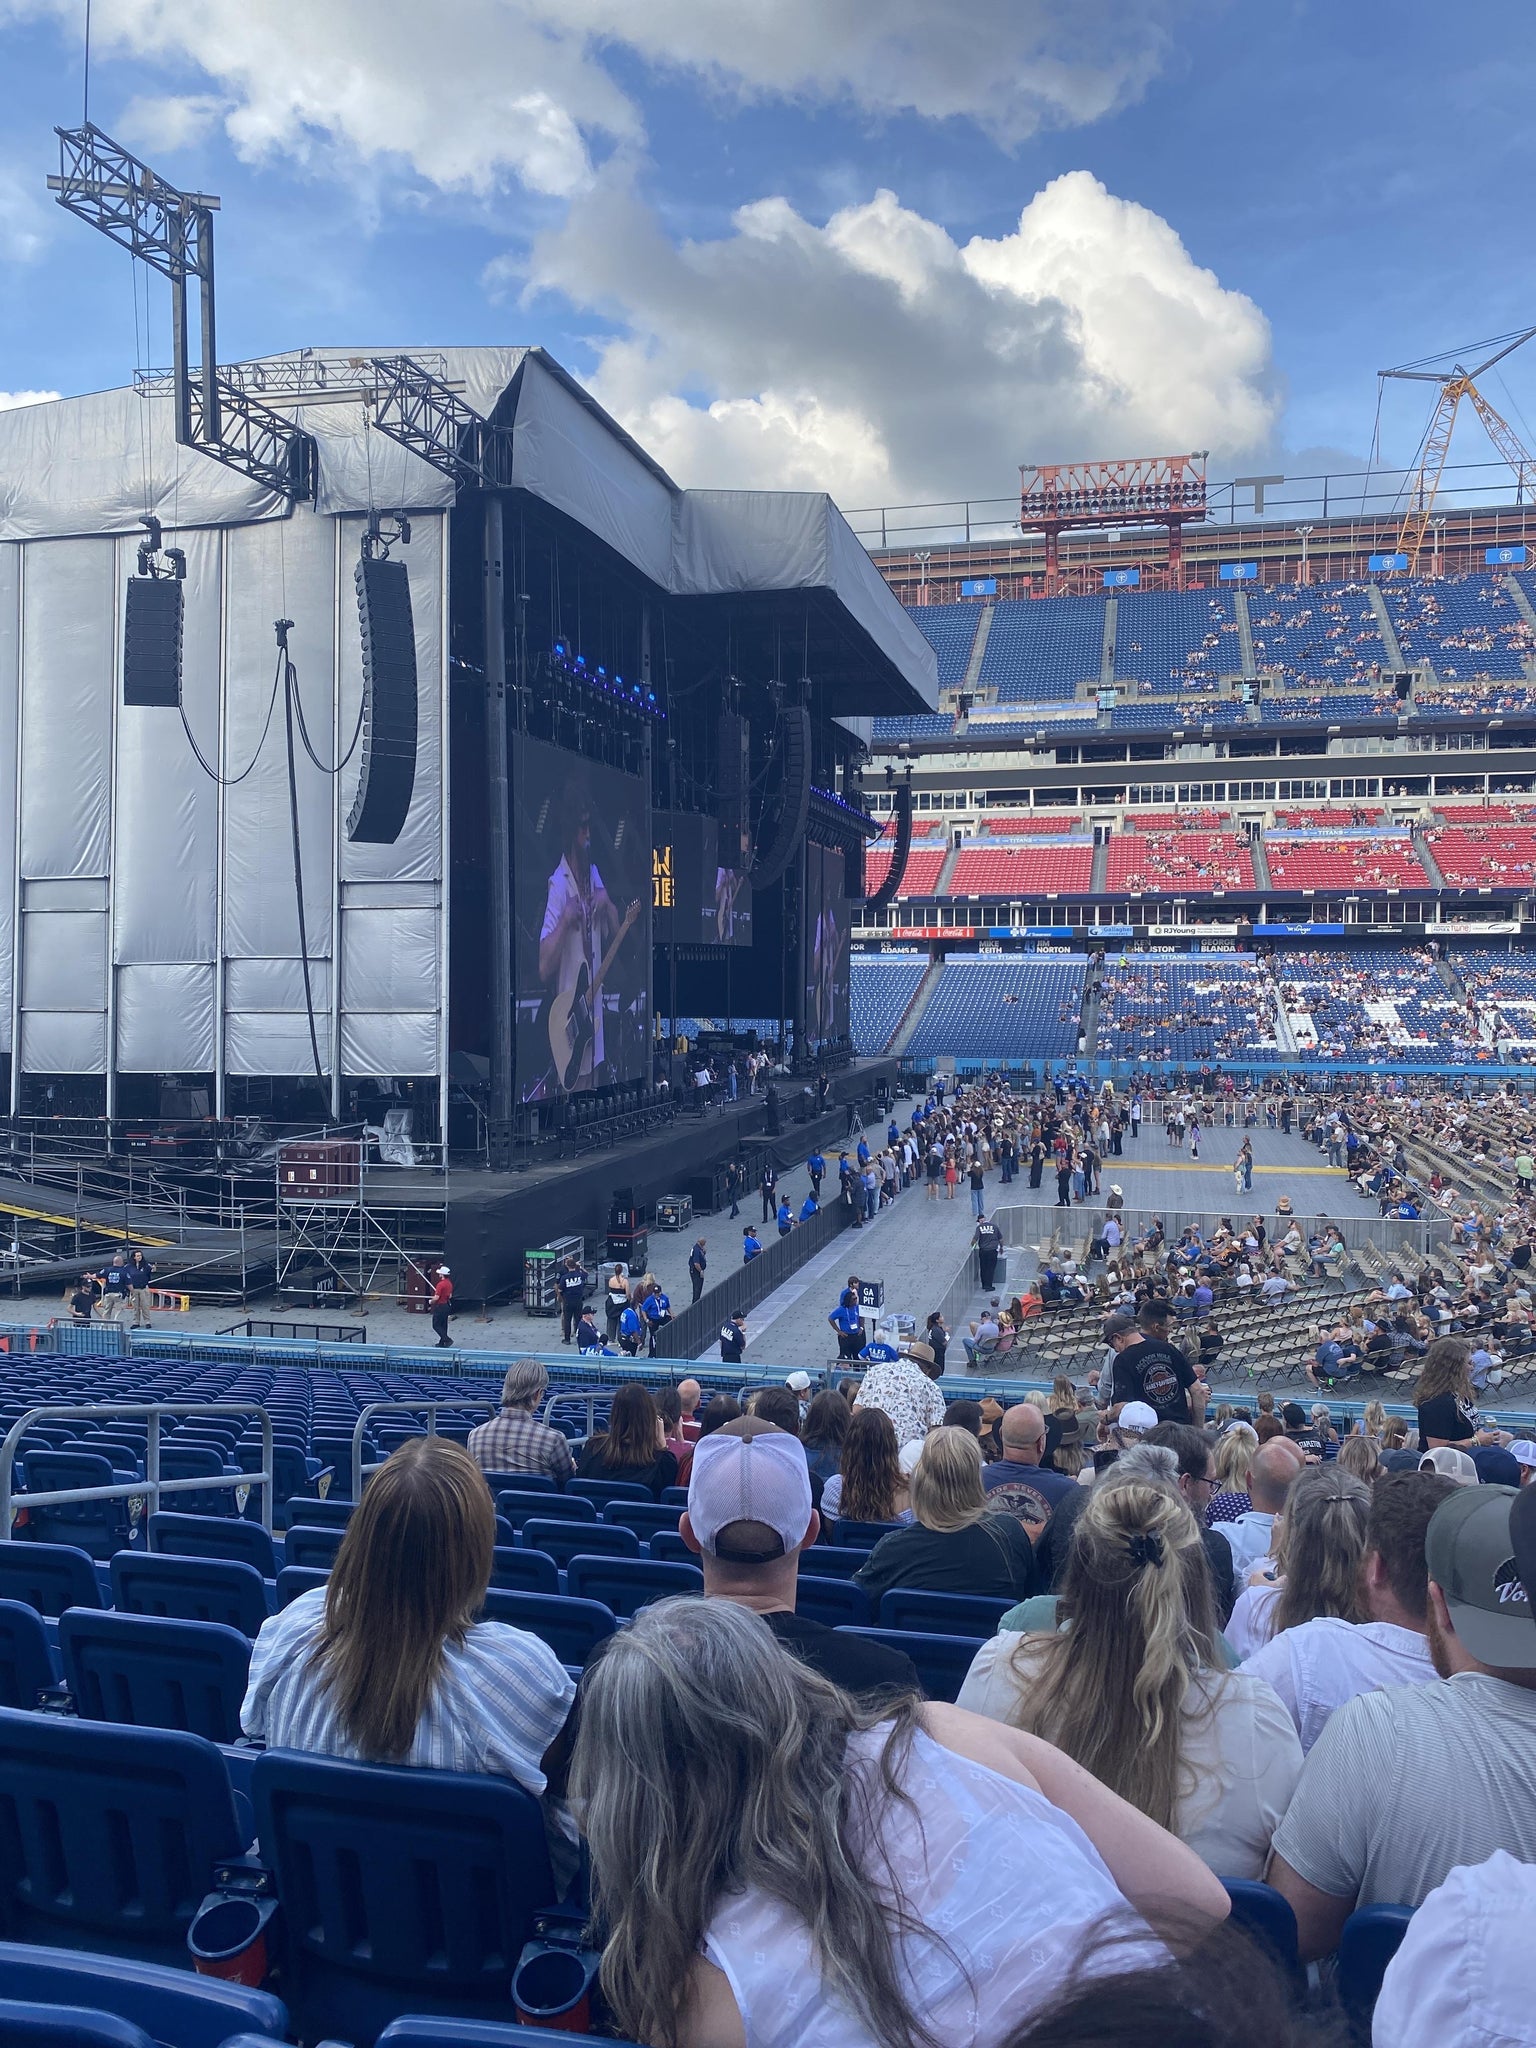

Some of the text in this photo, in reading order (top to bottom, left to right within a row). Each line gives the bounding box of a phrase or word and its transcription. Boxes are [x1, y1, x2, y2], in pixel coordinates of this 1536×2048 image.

[1163, 927, 1196, 935] RJYoung
[1036, 946, 1071, 954] NORTON
[1200, 945, 1236, 953] BLANDA
[863, 1287, 874, 1297] GA
[863, 1296, 874, 1305] PIT
[1013, 1484, 1044, 1501] NEVER
[1495, 1581, 1528, 1603] Vo
